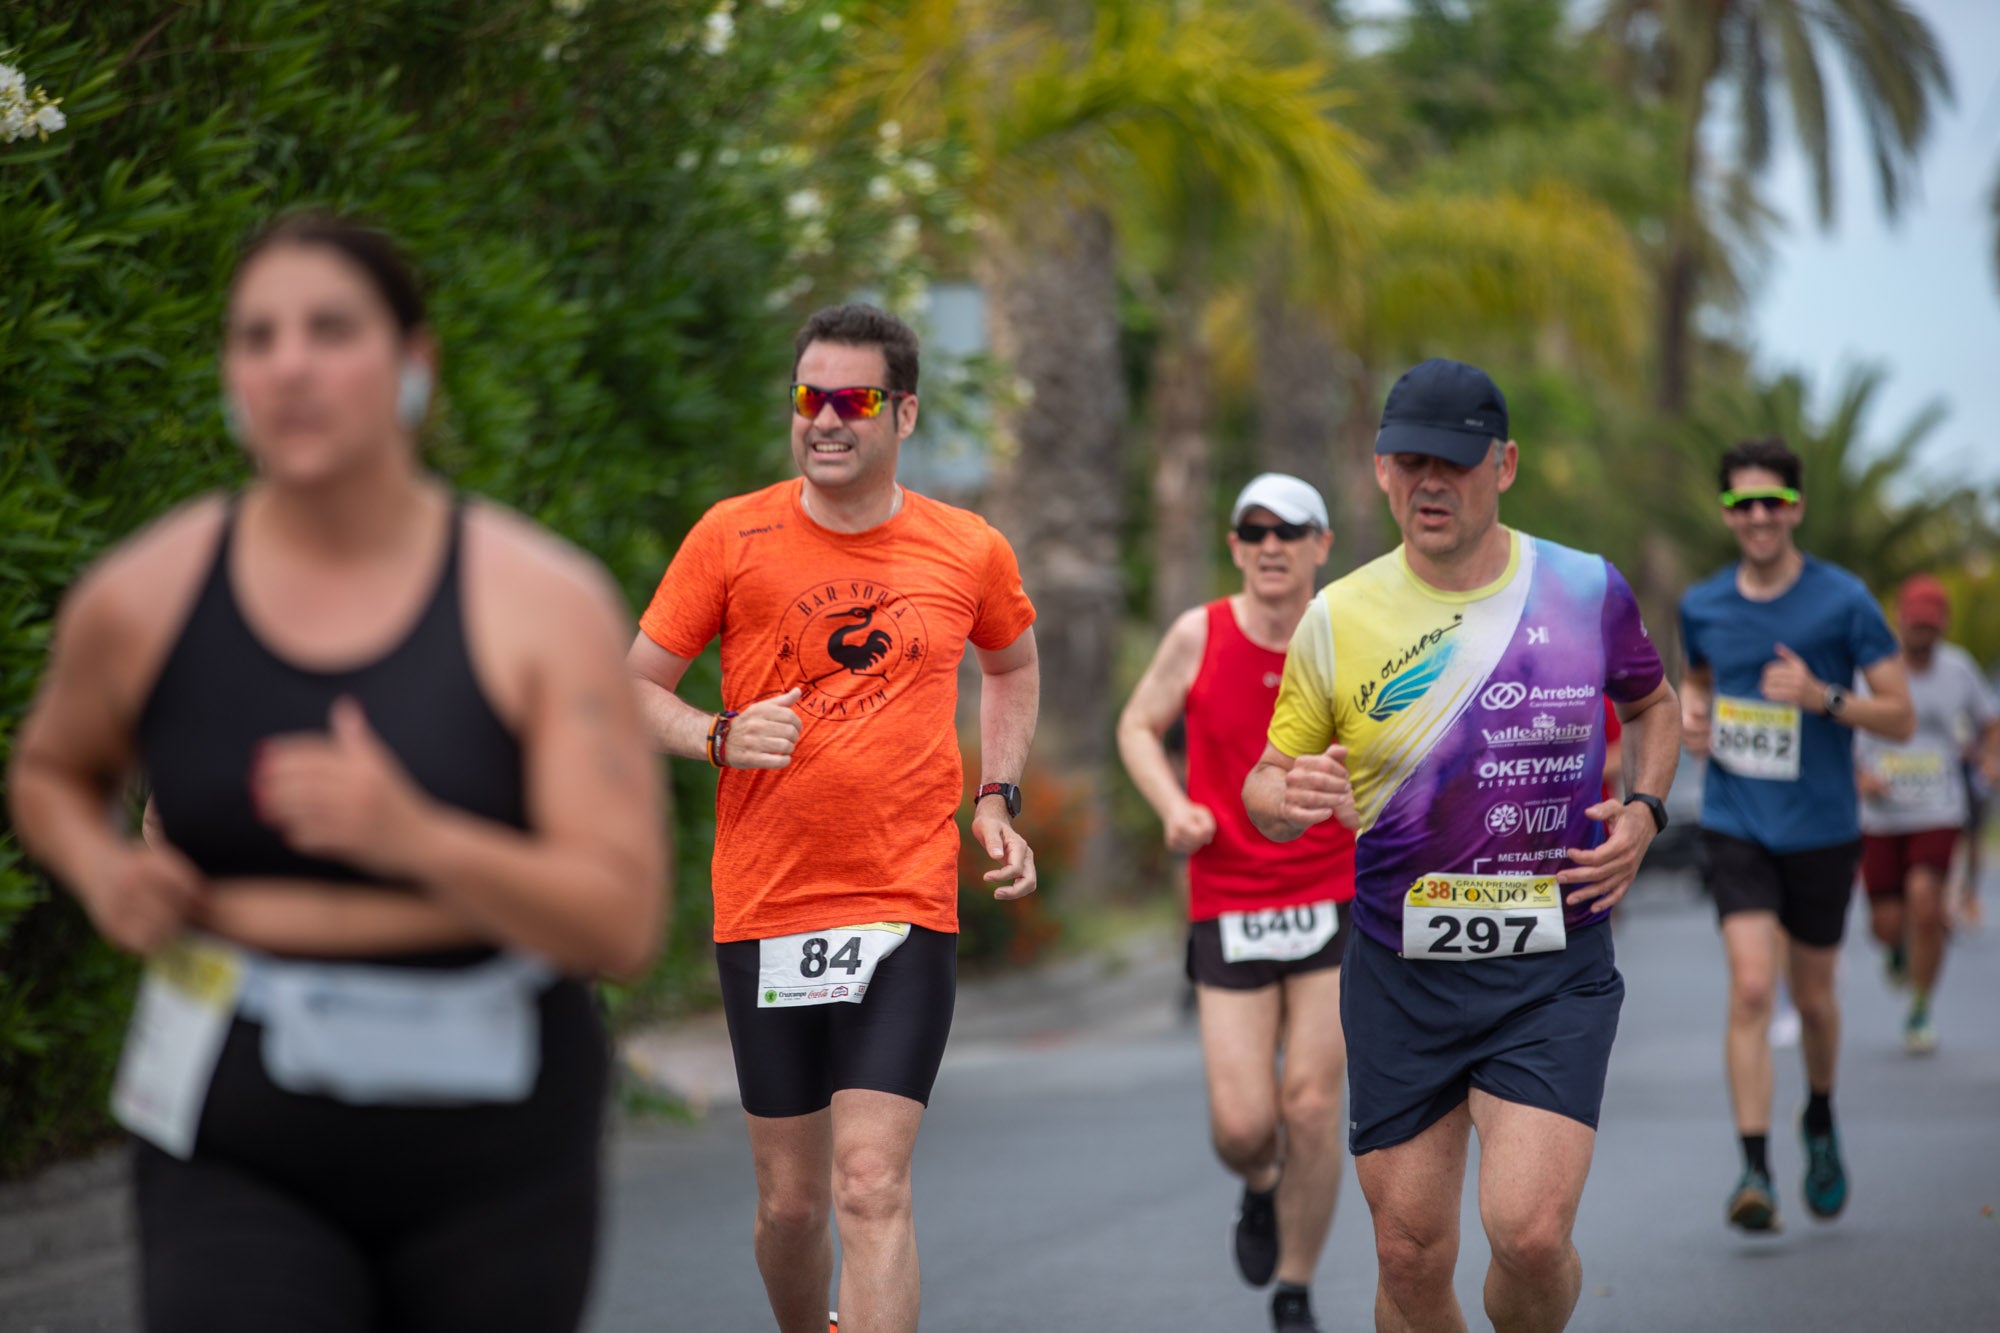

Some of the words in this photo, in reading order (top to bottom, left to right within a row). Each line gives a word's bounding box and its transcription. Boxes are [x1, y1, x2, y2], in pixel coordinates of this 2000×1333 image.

[798, 586, 838, 616] BAR
[1528, 684, 1596, 700] Arrebola
[1481, 723, 1593, 743] Valleaguirre
[1479, 753, 1585, 779] OKEYMAS
[1478, 776, 1548, 789] FITNESS
[1553, 771, 1583, 783] CLUB
[1524, 804, 1568, 834] VIDA
[1497, 846, 1569, 863] METALISTERÍ
[1427, 880, 1450, 899] 38
[1455, 880, 1483, 889] GRAN
[1486, 881, 1519, 889] PREMIO
[1452, 887, 1527, 903] FONDO
[1242, 906, 1316, 942] 640
[1428, 915, 1538, 954] 297
[800, 937, 862, 979] 84
